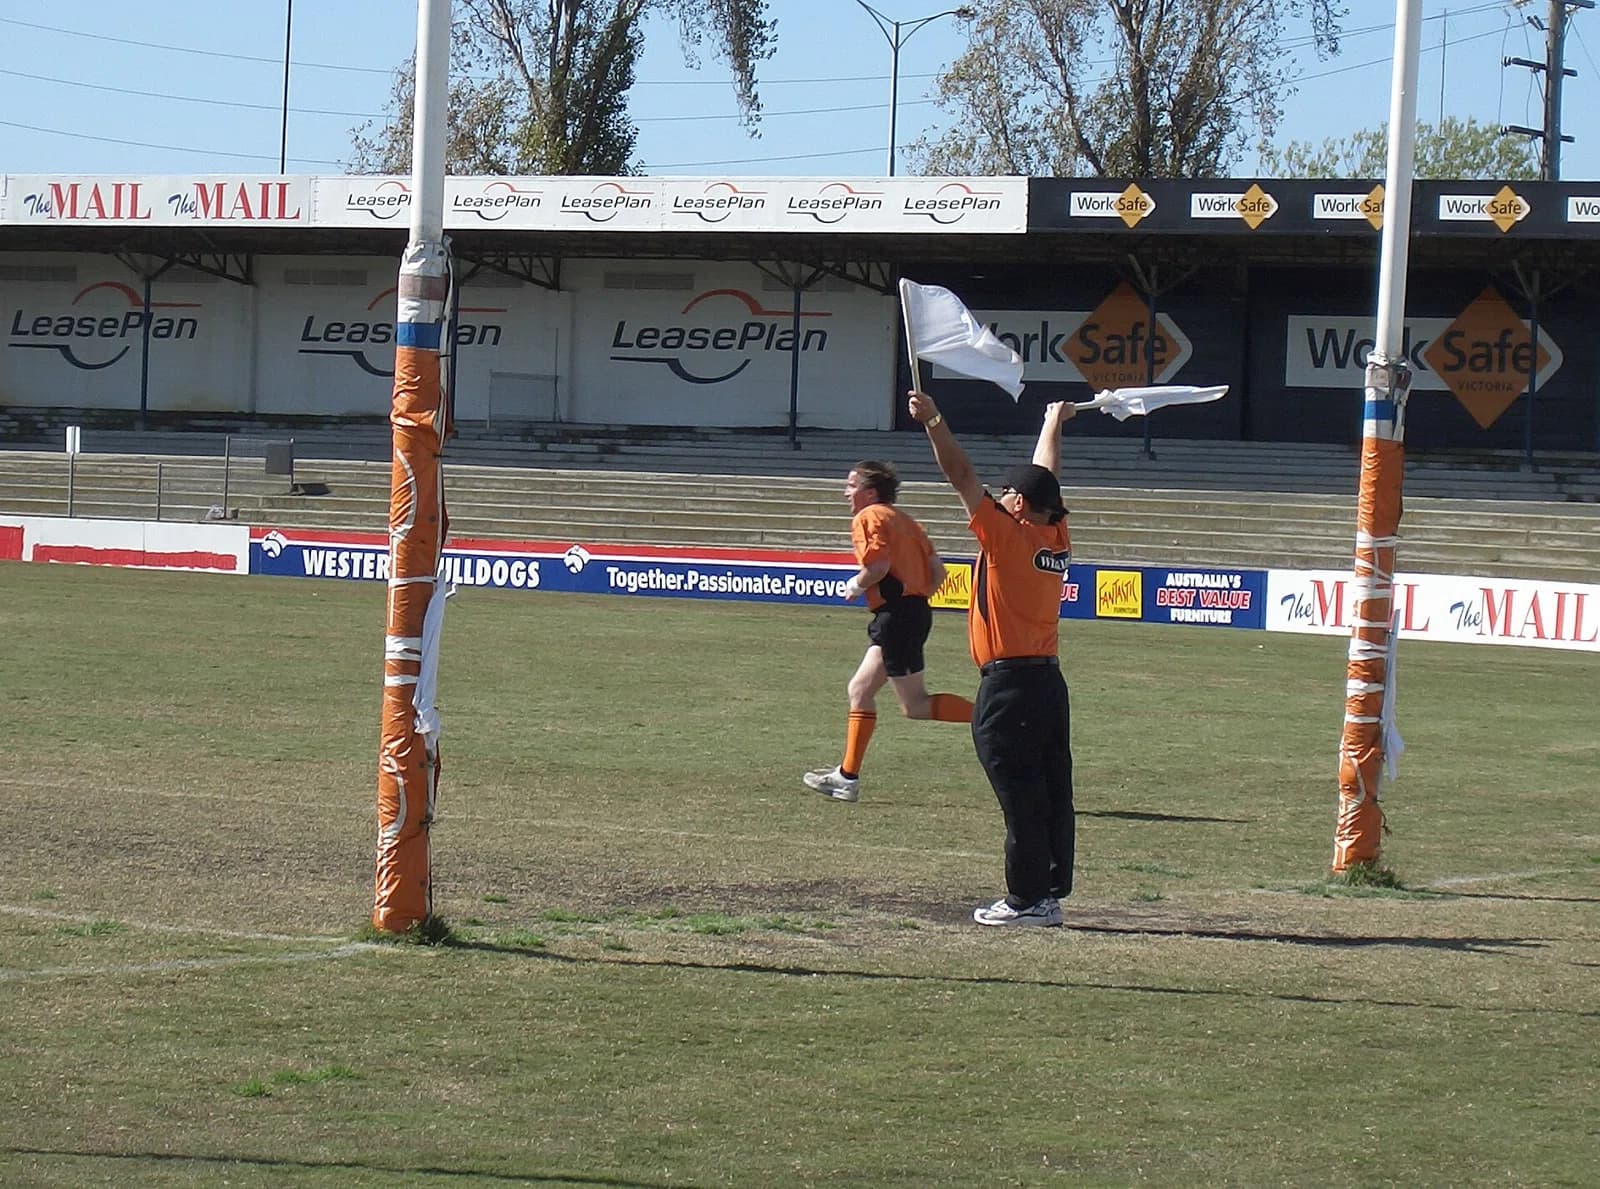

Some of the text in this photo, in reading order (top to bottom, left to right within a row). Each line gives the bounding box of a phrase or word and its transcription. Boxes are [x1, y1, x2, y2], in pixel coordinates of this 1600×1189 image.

[24, 183, 152, 220] The MAIL
[168, 182, 300, 220] The MAIL
[347, 193, 412, 206] LeasePl
[453, 194, 541, 208] LeasePlan
[561, 195, 651, 209] LeasePlan
[673, 195, 765, 209] LeasePlan
[787, 195, 882, 210] LeasePlan
[903, 196, 1000, 210] LeasePlan
[1077, 197, 1148, 211] Work Safe
[1198, 197, 1270, 213] Work Safe
[1321, 198, 1385, 213] Work Sa
[1447, 199, 1522, 215] Work Safe
[1576, 201, 1600, 216] Wo
[301, 316, 502, 346] Leasan
[611, 320, 828, 352] LeasePlan
[990, 321, 1168, 365] ork Safe
[1306, 326, 1538, 375] Wok Safe
[1457, 380, 1513, 393] VICTORIA
[302, 549, 540, 588] WESTER ULLDOGS
[1166, 573, 1241, 588] AUSTRALIA'S
[1099, 575, 1138, 614] FANTASTIC
[1157, 588, 1251, 609] BEST VALUE
[1280, 580, 1430, 632] The ML
[1170, 608, 1232, 623] FURNITURE
[1449, 588, 1599, 642] The MAIL
